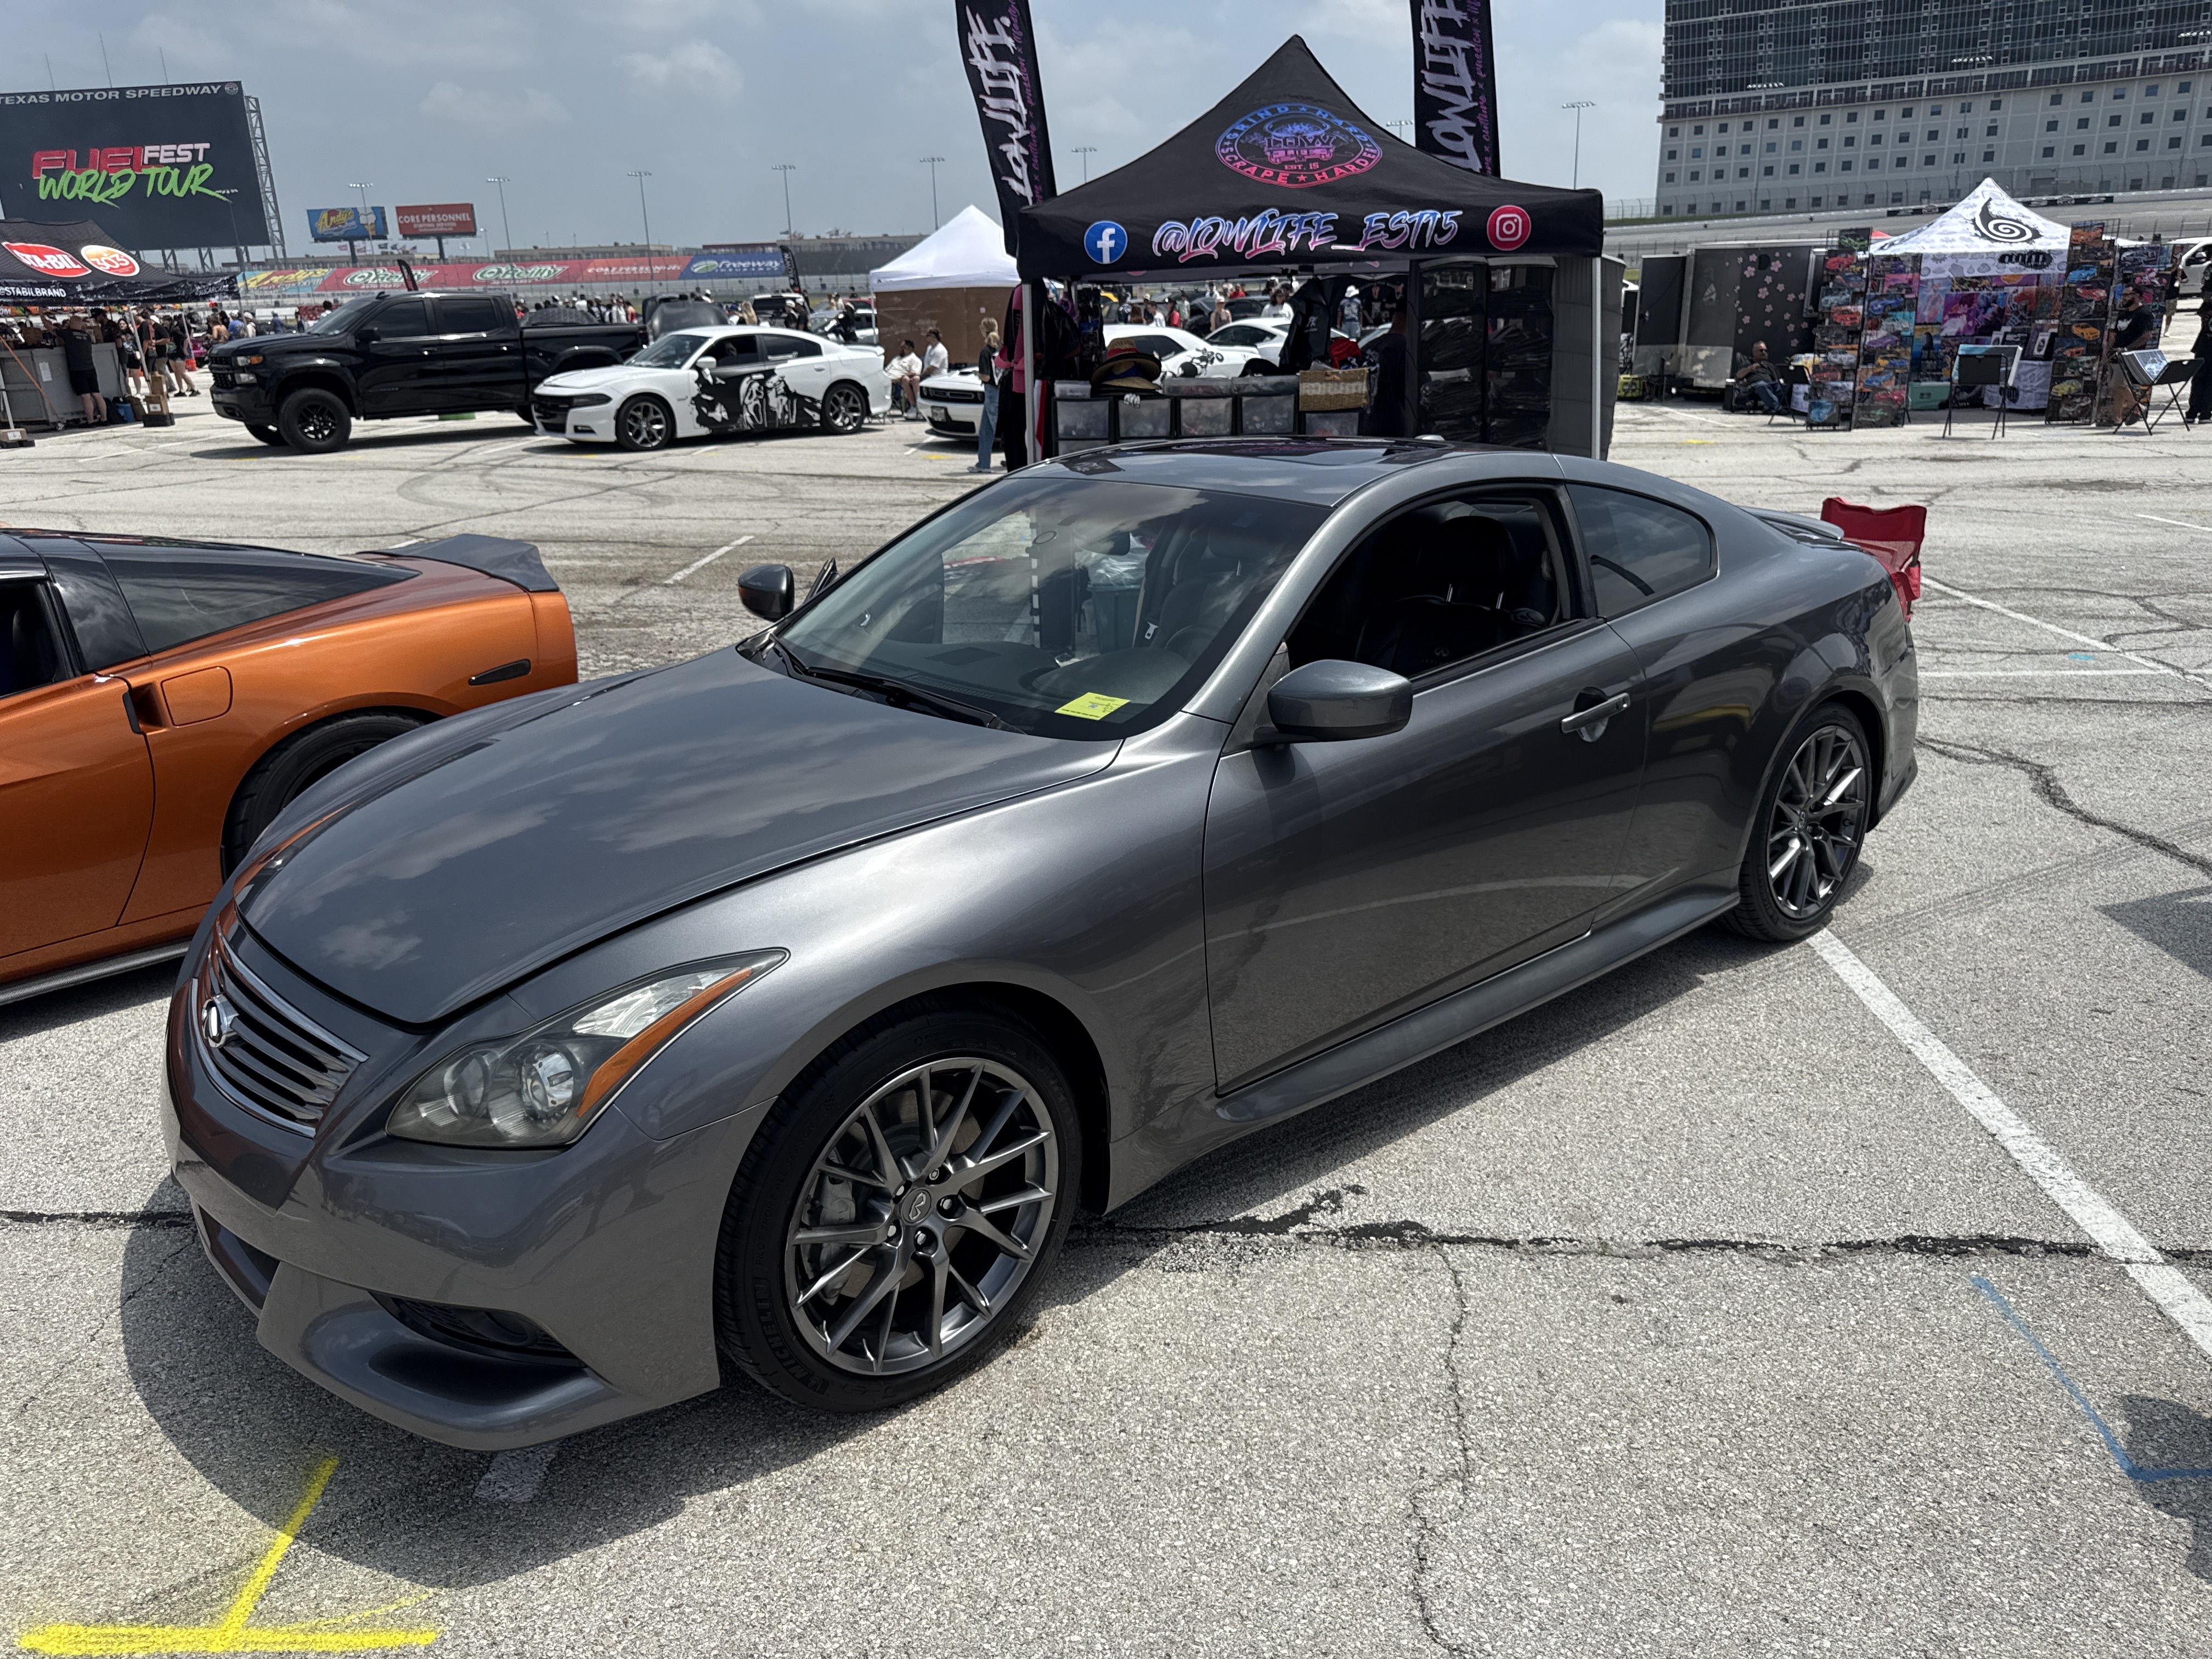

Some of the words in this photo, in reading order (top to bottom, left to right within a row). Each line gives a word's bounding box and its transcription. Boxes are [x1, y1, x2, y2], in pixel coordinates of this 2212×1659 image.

[0, 94, 50, 105] TEXAS
[55, 90, 120, 103] MOTOR
[126, 84, 222, 99] SPEEDWAY
[1221, 146, 1289, 184] SCRAPE
[39, 168, 137, 208] WORLD
[142, 163, 233, 203] TOUR
[398, 215, 420, 224] CORE
[422, 212, 471, 222] PERSONNEL
[14, 250, 82, 269] STA-BIL
[91, 253, 130, 270] 303
[0, 286, 67, 298] @STABILBRAND
[783, 1121, 816, 1168] SEASON
[772, 1169, 788, 1191] ALL
[759, 1193, 777, 1233] SPORT
[755, 1235, 766, 1268] PILOT
[754, 1278, 810, 1385] MICHELIN
